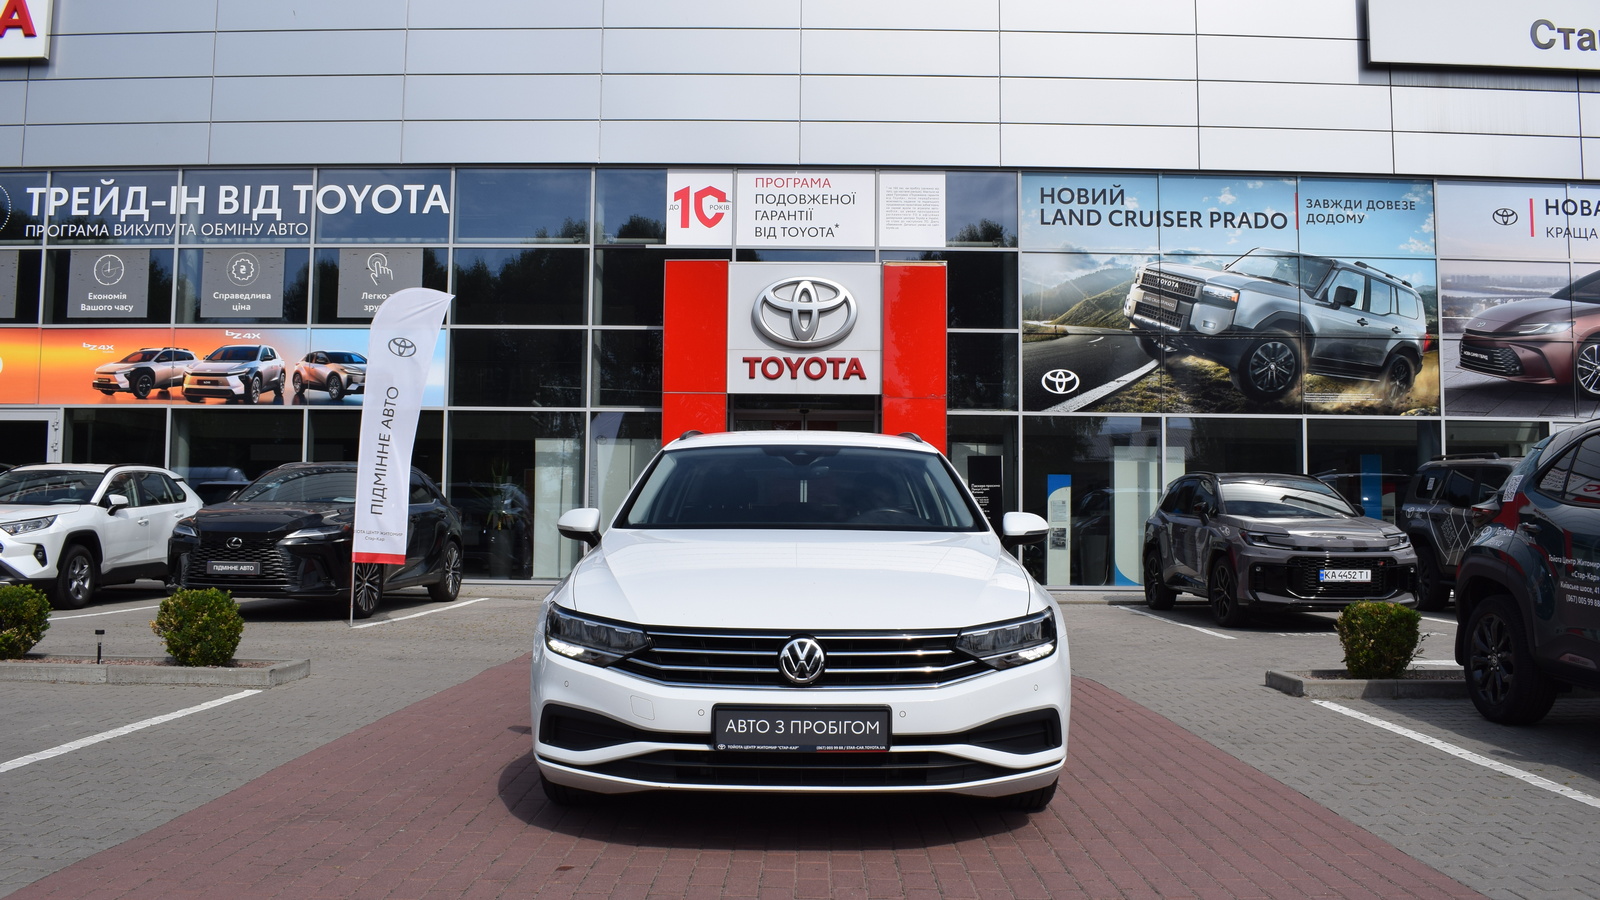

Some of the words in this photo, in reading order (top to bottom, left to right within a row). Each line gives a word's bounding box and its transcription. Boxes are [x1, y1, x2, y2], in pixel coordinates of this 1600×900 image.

[1530, 19, 1600, 51] Ста
[755, 177, 832, 188] ПРОГРАМА
[26, 178, 206, 222] ТРЕЙД-ІН
[218, 185, 282, 221] ВІД
[293, 184, 450, 215] TOYOTA
[755, 191, 857, 206] ПОДОВЖЕНОЇ
[1040, 184, 1125, 206] НОВИЙ
[1306, 198, 1363, 211] ЗАВЖДИ
[1366, 200, 1416, 212] ДОВЕЗЕ
[754, 208, 814, 221] ГАРАНТІЇ
[1040, 208, 1102, 226] LAND
[1108, 209, 1203, 228] CRUISER
[1209, 211, 1288, 229] PRADO
[1306, 213, 1365, 225] ДОДОМУ
[25, 224, 109, 237] ПРОГРАМА
[114, 223, 176, 237] ВИКУПУ
[178, 223, 197, 236] ТА
[201, 222, 264, 236] ОБМІНУ
[267, 222, 309, 236] АВТО
[755, 226, 777, 239] ВІД
[1546, 227, 1599, 241] КРАЩА
[1156, 278, 1179, 288] TOYOTA
[88, 292, 127, 300] Економія
[213, 291, 272, 301] Справедлива
[361, 292, 387, 300] Легко
[80, 303, 113, 311] Вашого
[114, 304, 134, 313] часу
[232, 303, 251, 311] ціна
[363, 304, 381, 312] зру
[743, 356, 867, 380] TOYOTA
[370, 433, 391, 515] ПІДМІННЕ
[382, 386, 399, 429] АВТО
[1562, 556, 1577, 566] Центр
[1577, 558, 1600, 569] Житомир
[1338, 571, 1357, 580] 4452
[725, 719, 770, 733] АВТО
[790, 720, 880, 734] ПРОБІГОМ
